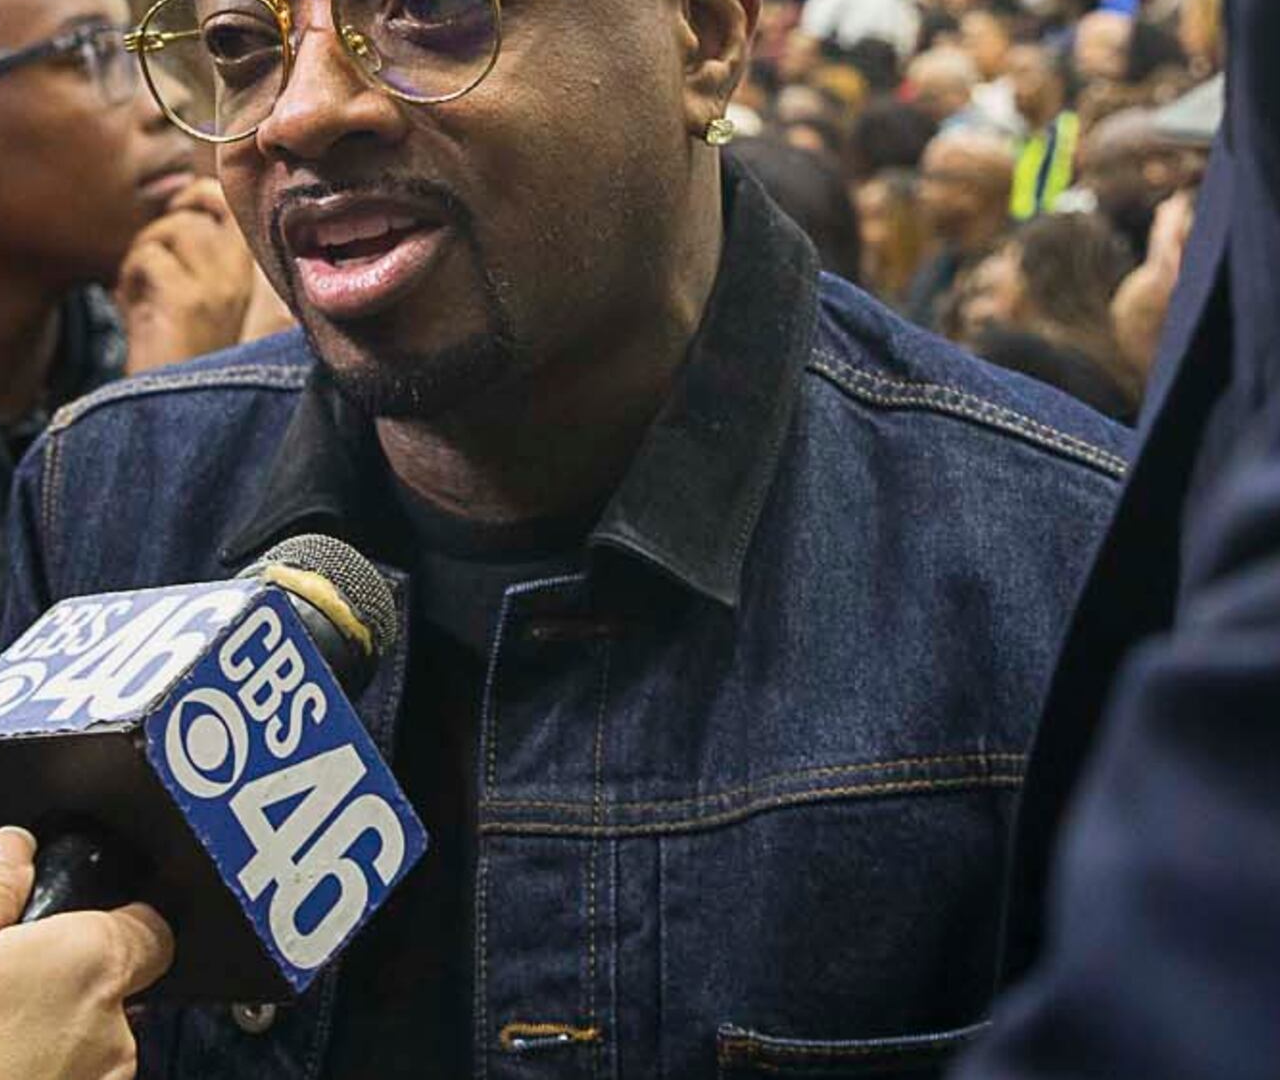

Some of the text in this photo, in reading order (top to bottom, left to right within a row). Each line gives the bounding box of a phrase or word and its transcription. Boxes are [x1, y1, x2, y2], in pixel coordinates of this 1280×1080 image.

[6, 589, 246, 720] CBS 46
[220, 606, 326, 758] CBS
[229, 744, 404, 969] 46
